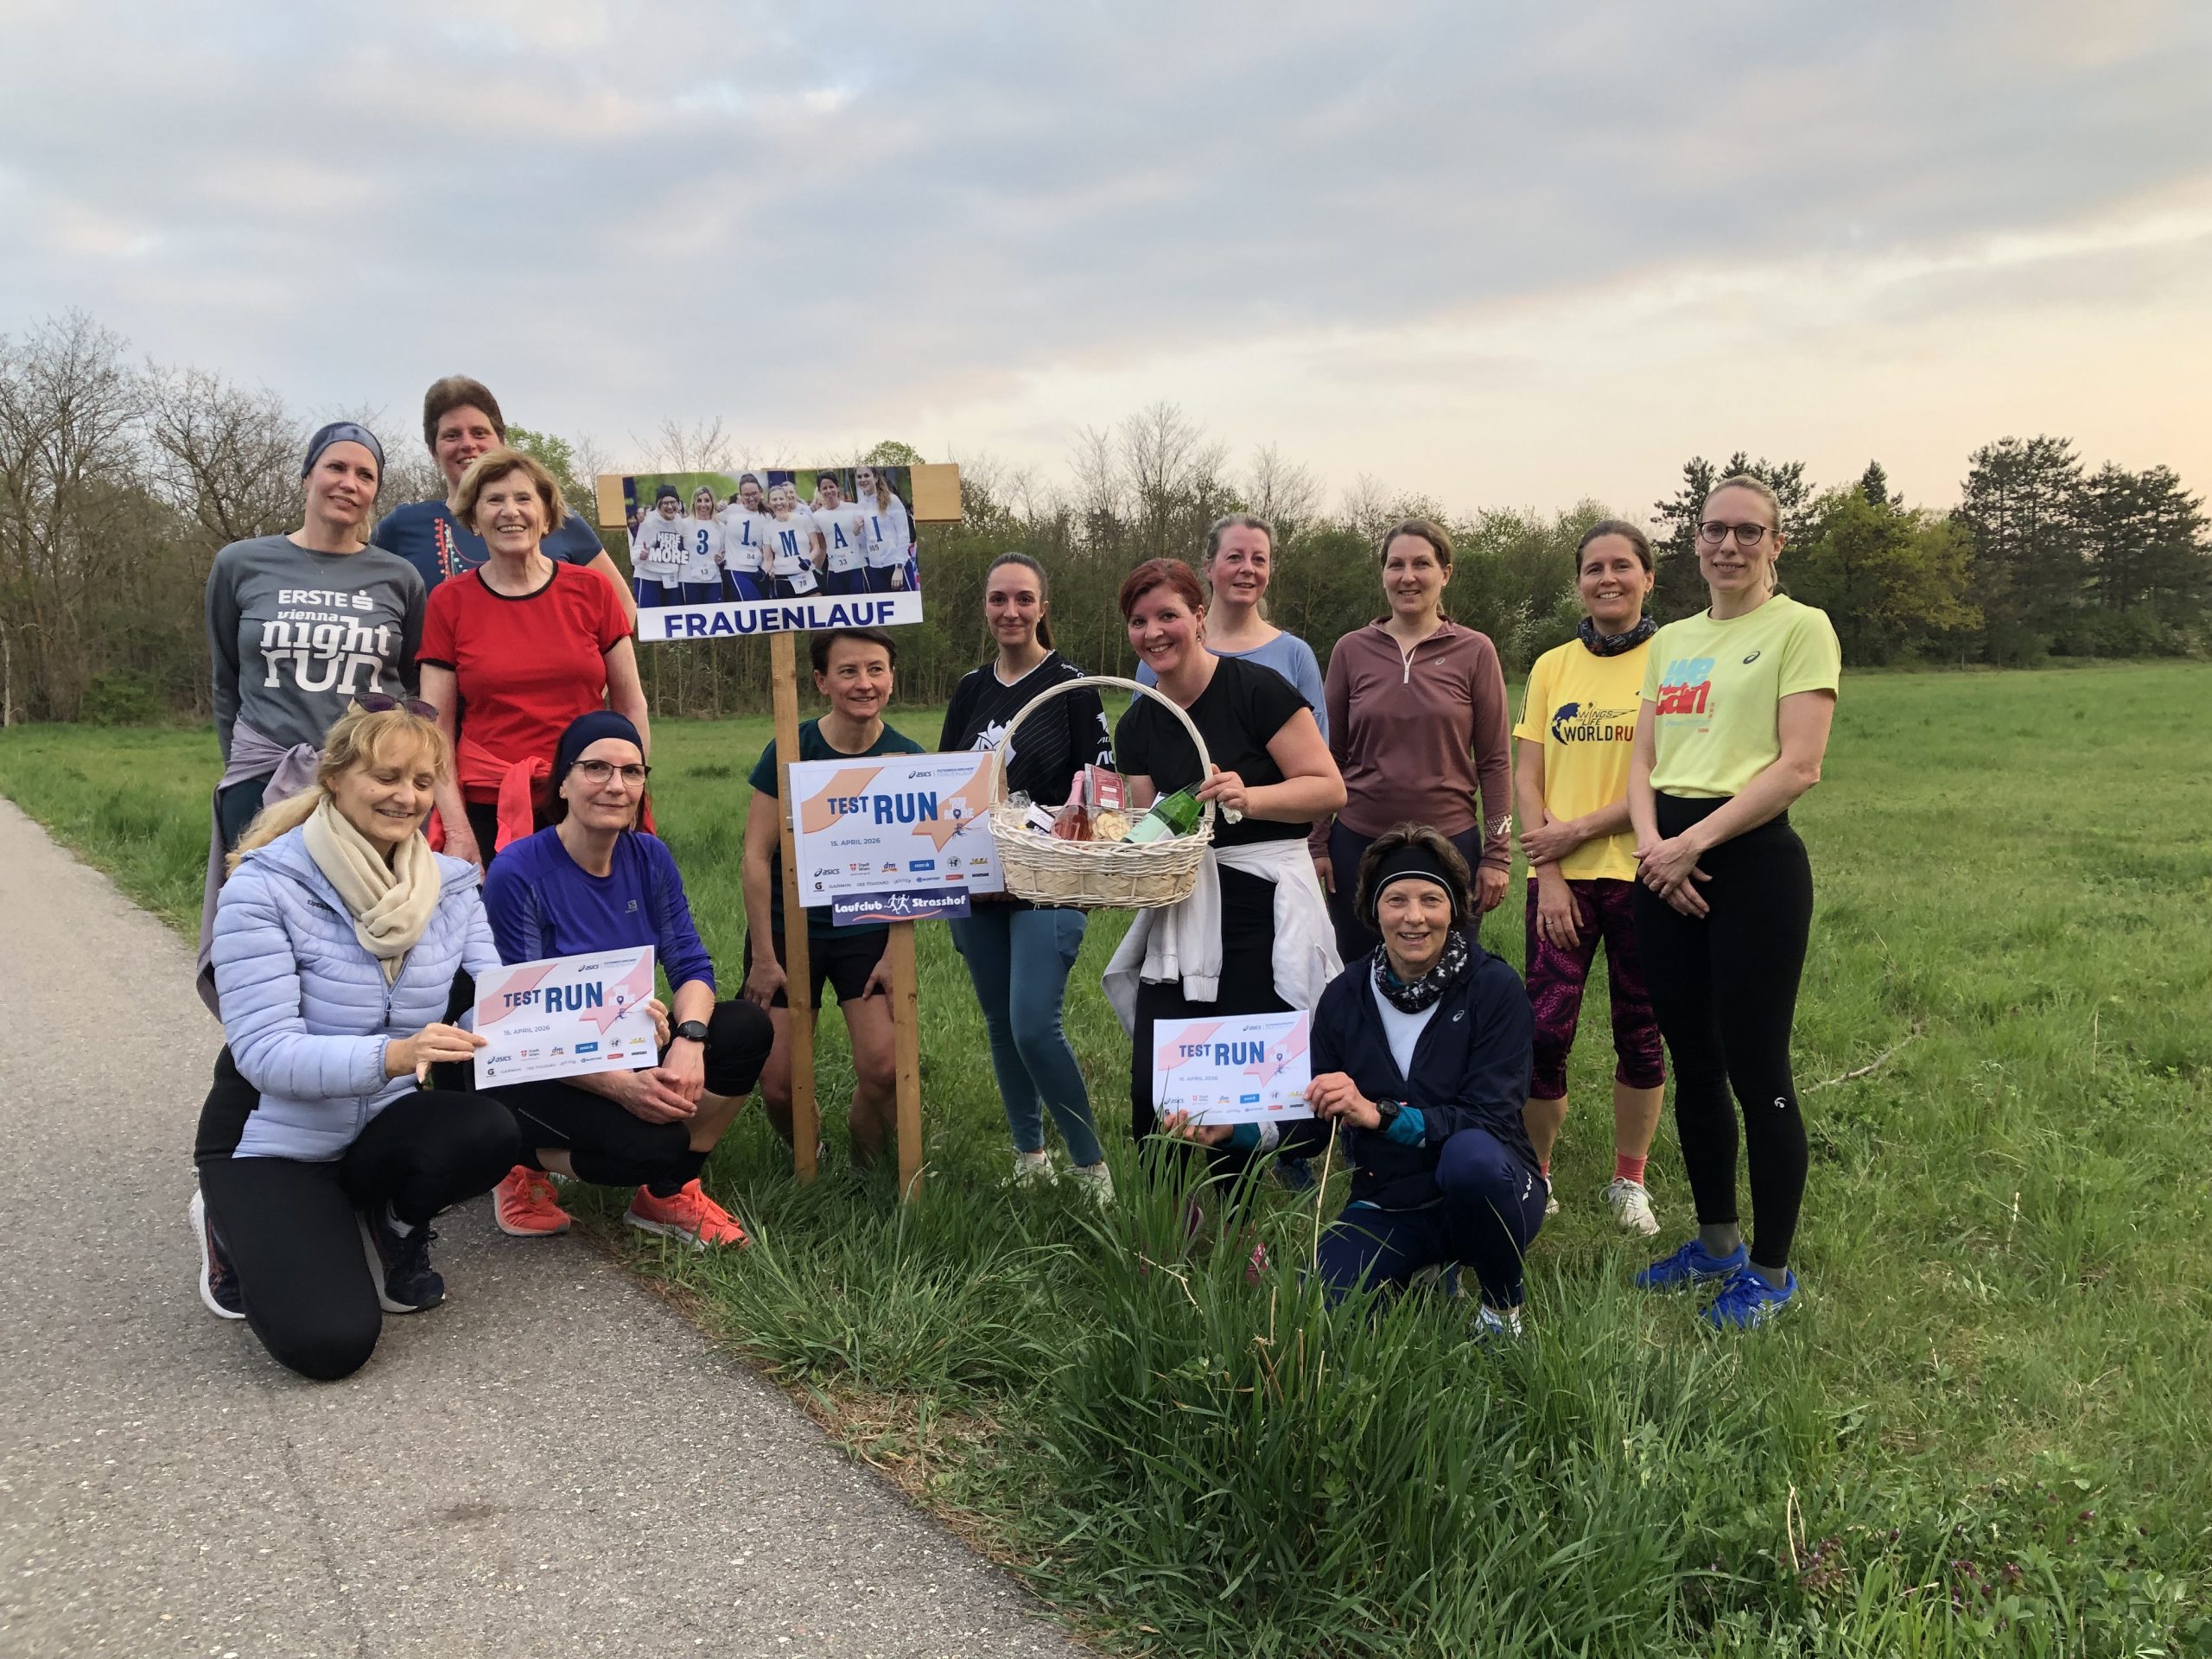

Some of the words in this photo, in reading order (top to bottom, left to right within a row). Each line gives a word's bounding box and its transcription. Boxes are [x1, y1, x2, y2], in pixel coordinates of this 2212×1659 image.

[657, 531, 682, 543] HERE
[659, 540, 679, 551] FOR
[696, 529, 709, 555] 3
[779, 529, 799, 557] M
[833, 522, 849, 549] A
[648, 548, 690, 564] MORE
[277, 589, 348, 607] ERSTE
[276, 608, 339, 622] vienna
[664, 601, 895, 639] FRAUENLAUF
[260, 615, 391, 659] night
[260, 649, 384, 695] run
[1615, 725, 1635, 742] RU
[827, 795, 869, 815] TEST
[874, 791, 938, 825] RUN
[835, 900, 883, 914] Laufclub
[912, 894, 967, 908] Strasshof
[504, 989, 541, 1008] TEST
[545, 981, 603, 1014] RUN
[1179, 1044, 1211, 1058] TEST
[1215, 1040, 1265, 1066] RUN
